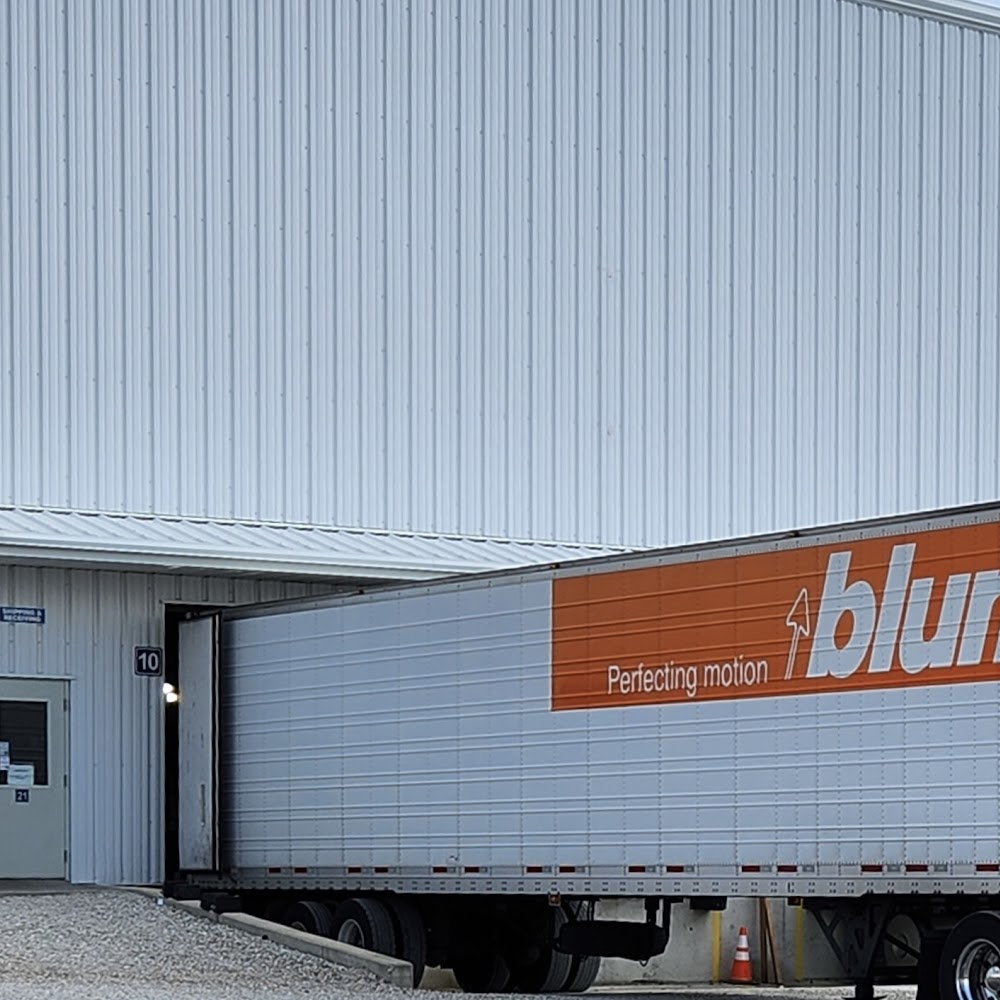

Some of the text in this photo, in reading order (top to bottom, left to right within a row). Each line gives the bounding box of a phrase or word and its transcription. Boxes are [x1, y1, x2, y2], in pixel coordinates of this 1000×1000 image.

[138, 652, 159, 671] 10
[606, 657, 768, 698] Perfecting motion
[17, 791, 28, 801] 21
